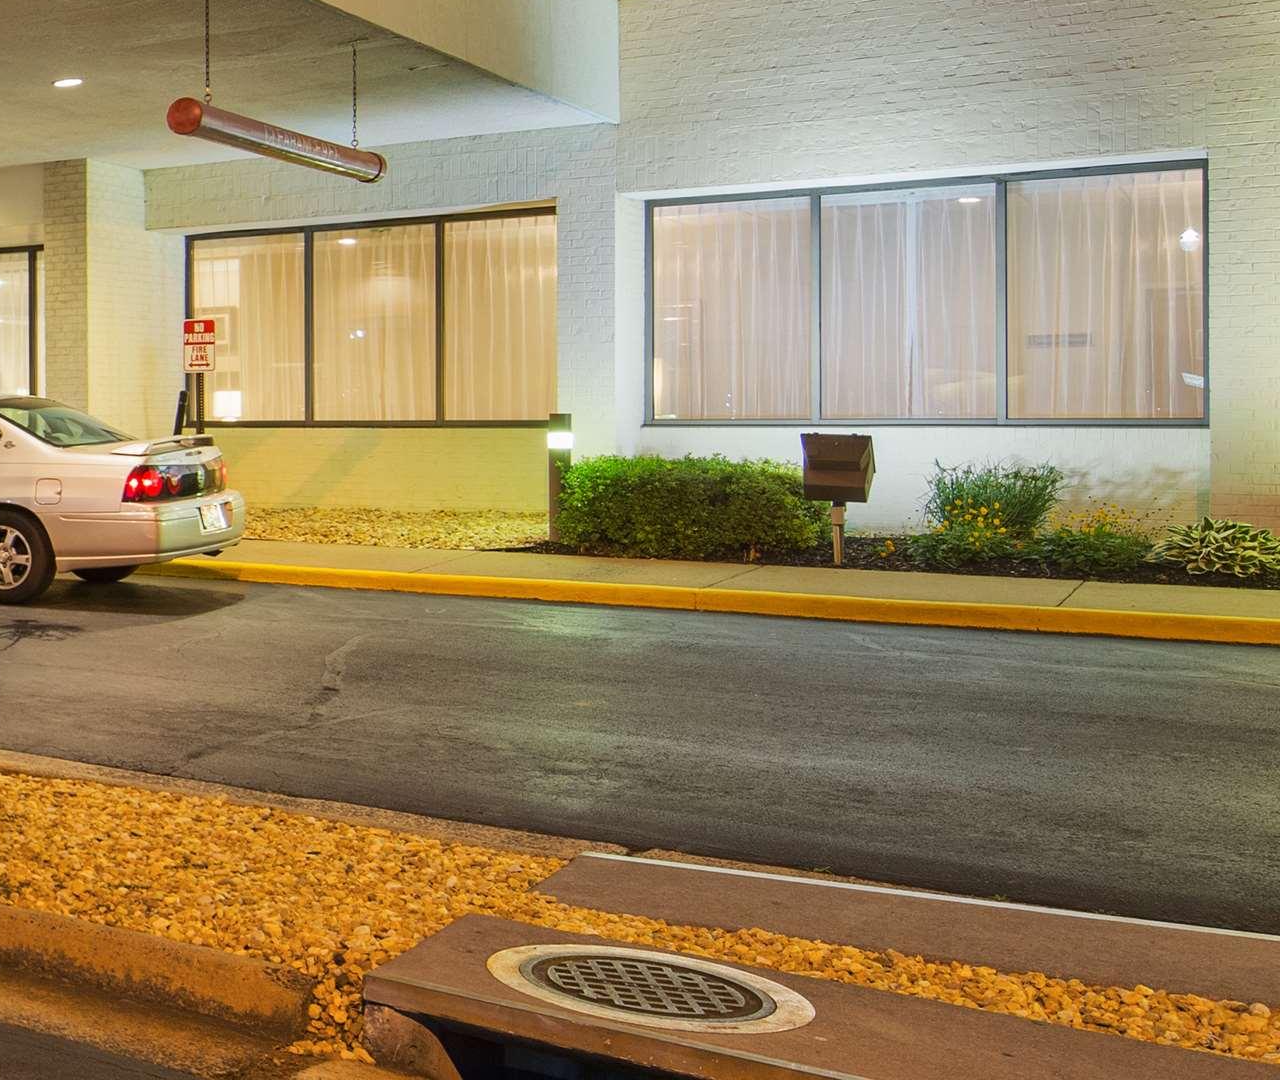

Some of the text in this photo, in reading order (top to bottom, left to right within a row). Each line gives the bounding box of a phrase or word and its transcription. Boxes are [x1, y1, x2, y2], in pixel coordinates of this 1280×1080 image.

[194, 322, 204, 332] NO
[185, 332, 215, 343] PARKING
[192, 345, 208, 353] FIRE
[191, 354, 208, 362] LANE
